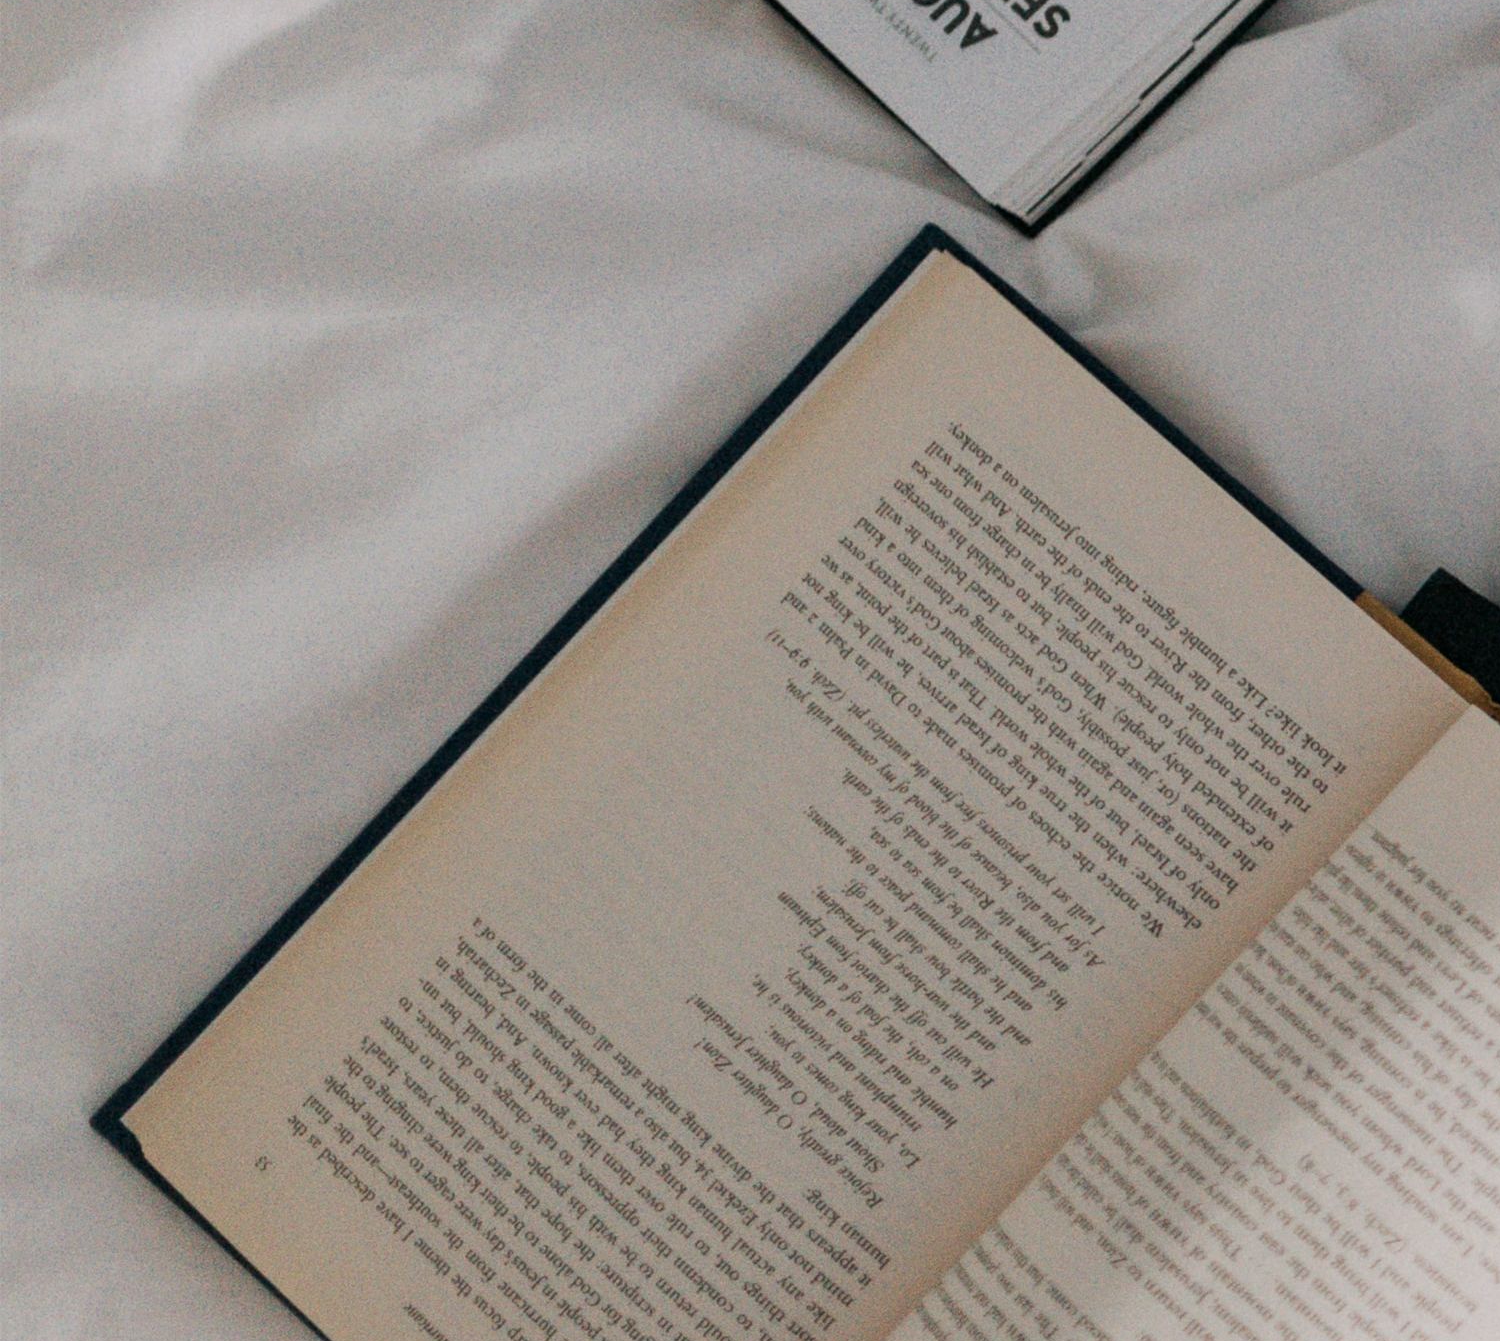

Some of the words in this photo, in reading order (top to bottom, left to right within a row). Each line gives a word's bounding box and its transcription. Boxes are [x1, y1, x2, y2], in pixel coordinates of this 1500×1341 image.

[691, 1035, 735, 1074] Zion!
[729, 1068, 782, 1117] daughter
[775, 1112, 795, 1132] O
[252, 1154, 274, 1175] 53
[796, 1124, 845, 1168] greatly,
[835, 1164, 886, 1211] Rejoice
